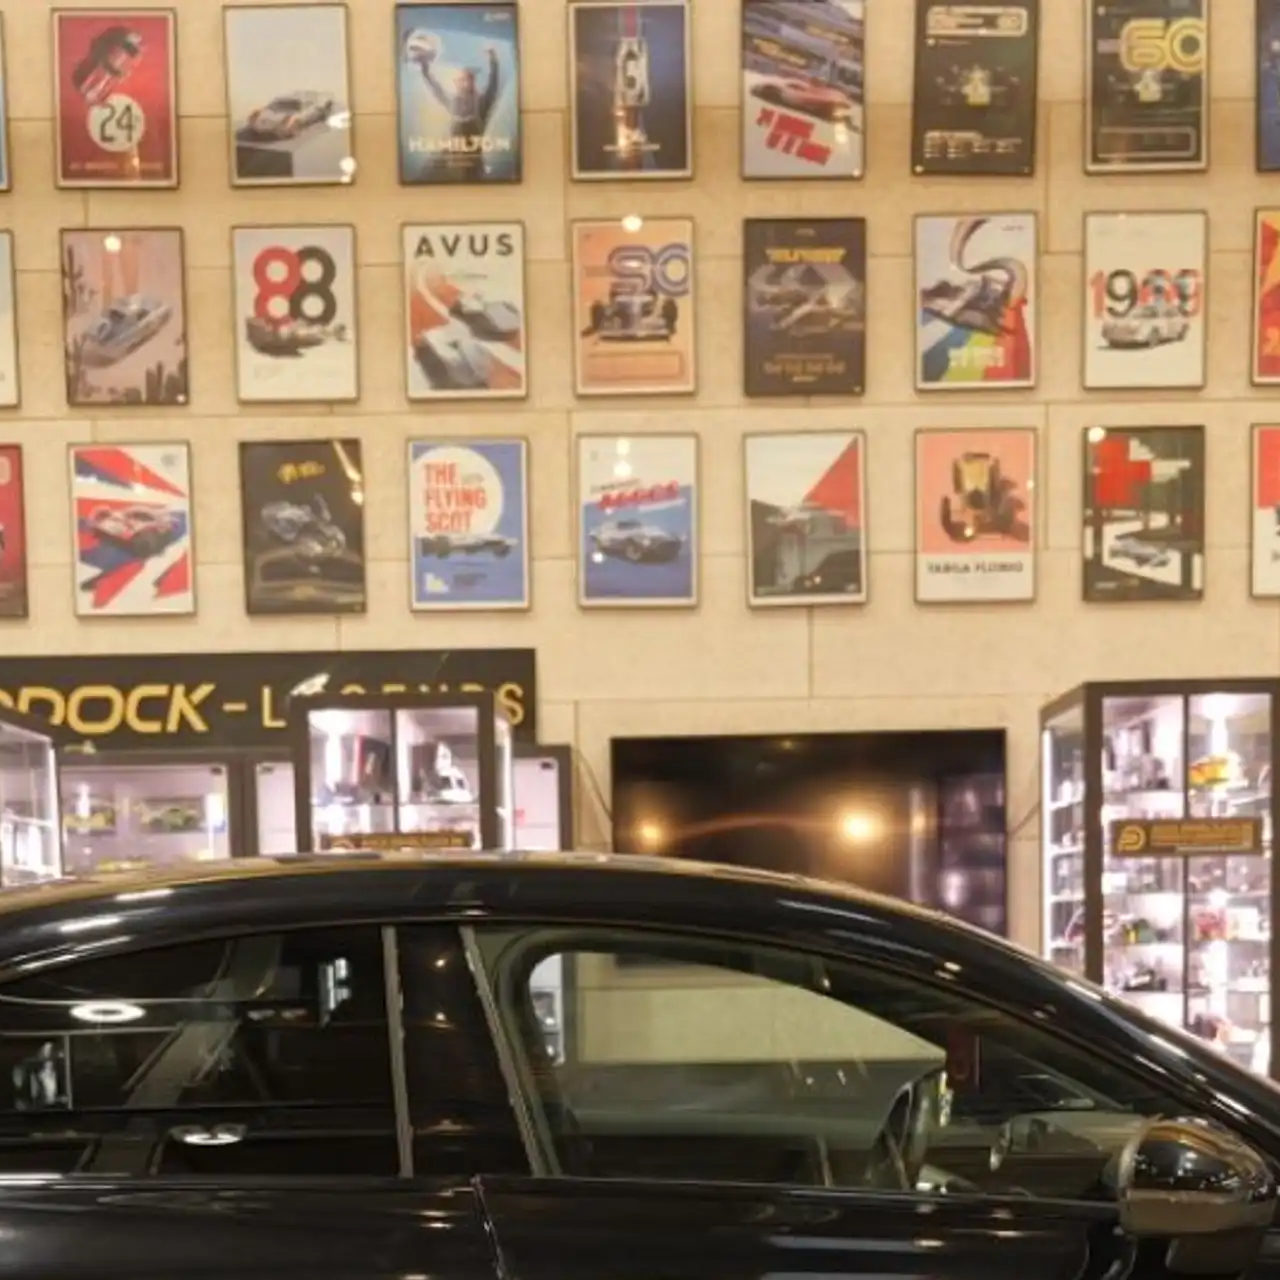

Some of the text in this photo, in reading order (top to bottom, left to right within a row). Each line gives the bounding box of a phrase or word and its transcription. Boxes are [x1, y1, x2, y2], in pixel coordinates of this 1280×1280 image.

[99, 103, 136, 143] 24
[409, 136, 510, 152] HAMILTON
[414, 233, 514, 258] AVUS
[254, 245, 337, 325] 88
[424, 462, 458, 485] THE
[424, 487, 486, 509] FLYING
[425, 510, 472, 533] SCOT
